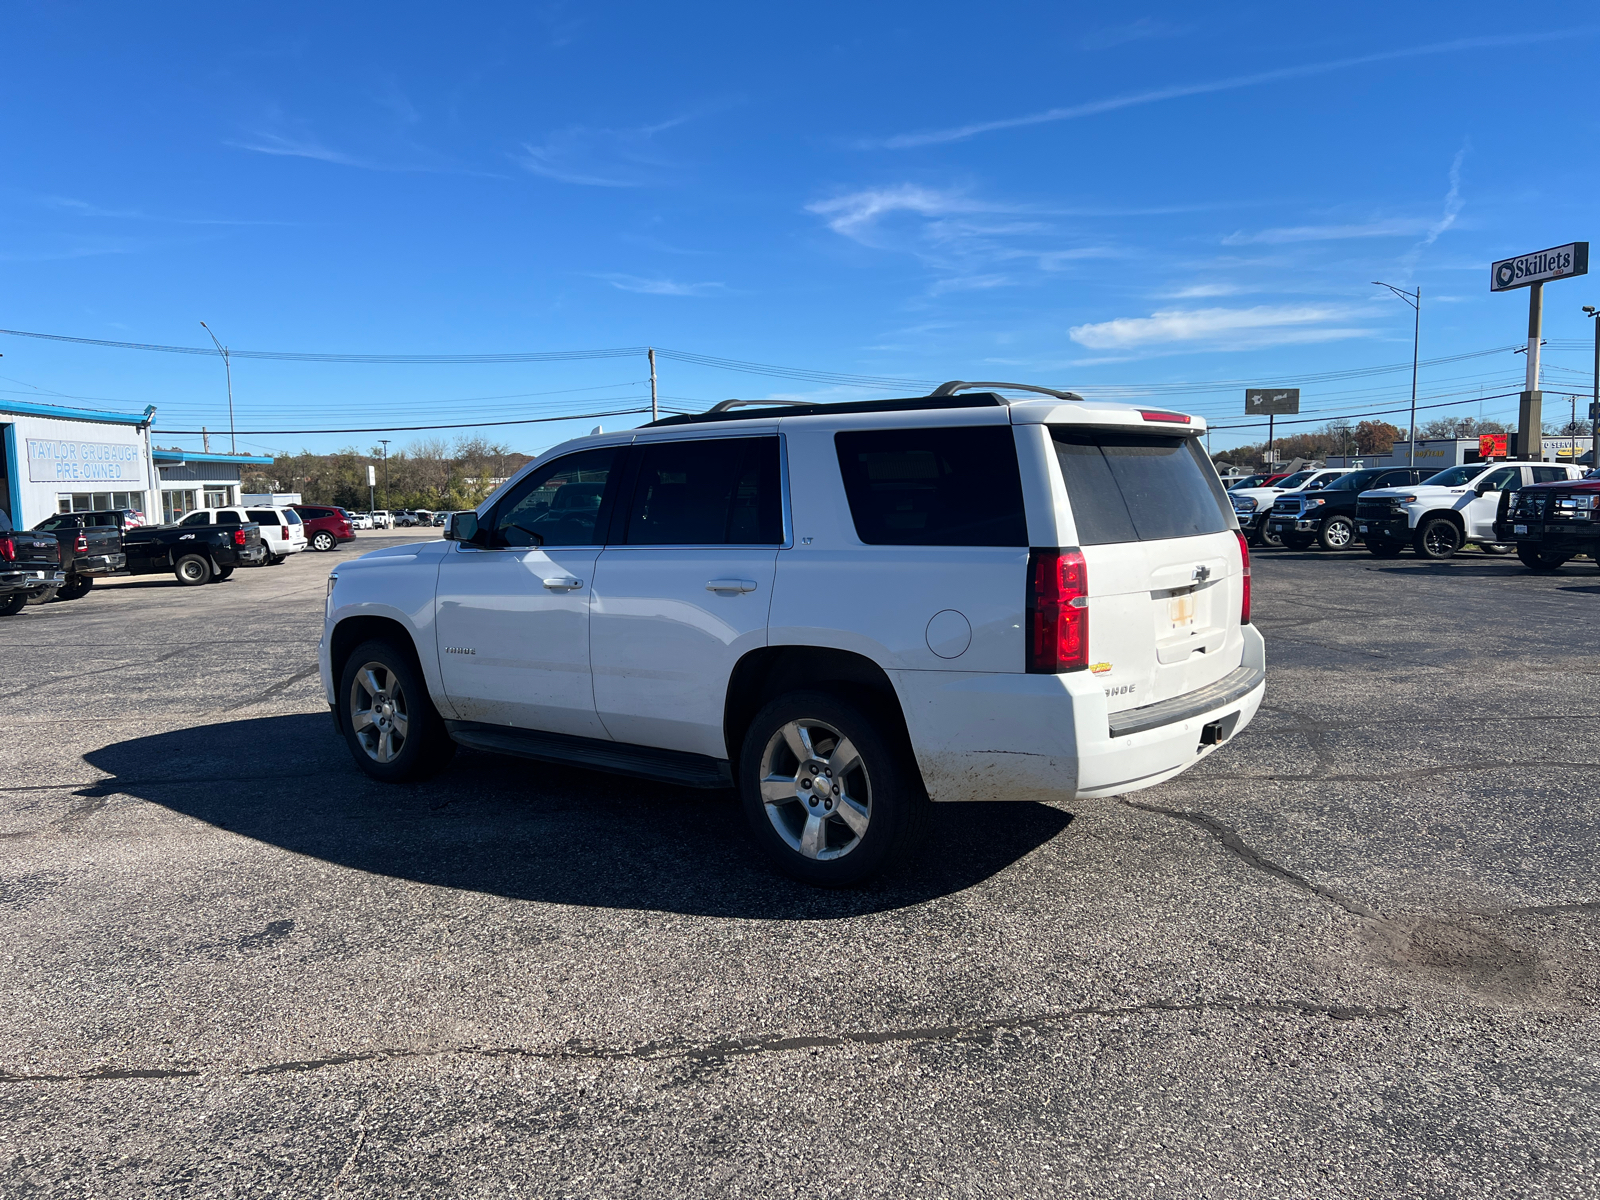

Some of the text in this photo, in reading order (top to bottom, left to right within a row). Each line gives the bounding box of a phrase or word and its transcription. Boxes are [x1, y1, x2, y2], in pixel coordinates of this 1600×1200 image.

[1515, 252, 1571, 279] Skillets
[1551, 441, 1582, 449] SERVIE
[29, 441, 139, 461] TAYLOR GRUBAUGH
[1404, 449, 1445, 459] GODYEAR
[55, 462, 122, 479] PRE-OWNED
[801, 537, 814, 545] LT
[445, 646, 476, 655] TAHOE
